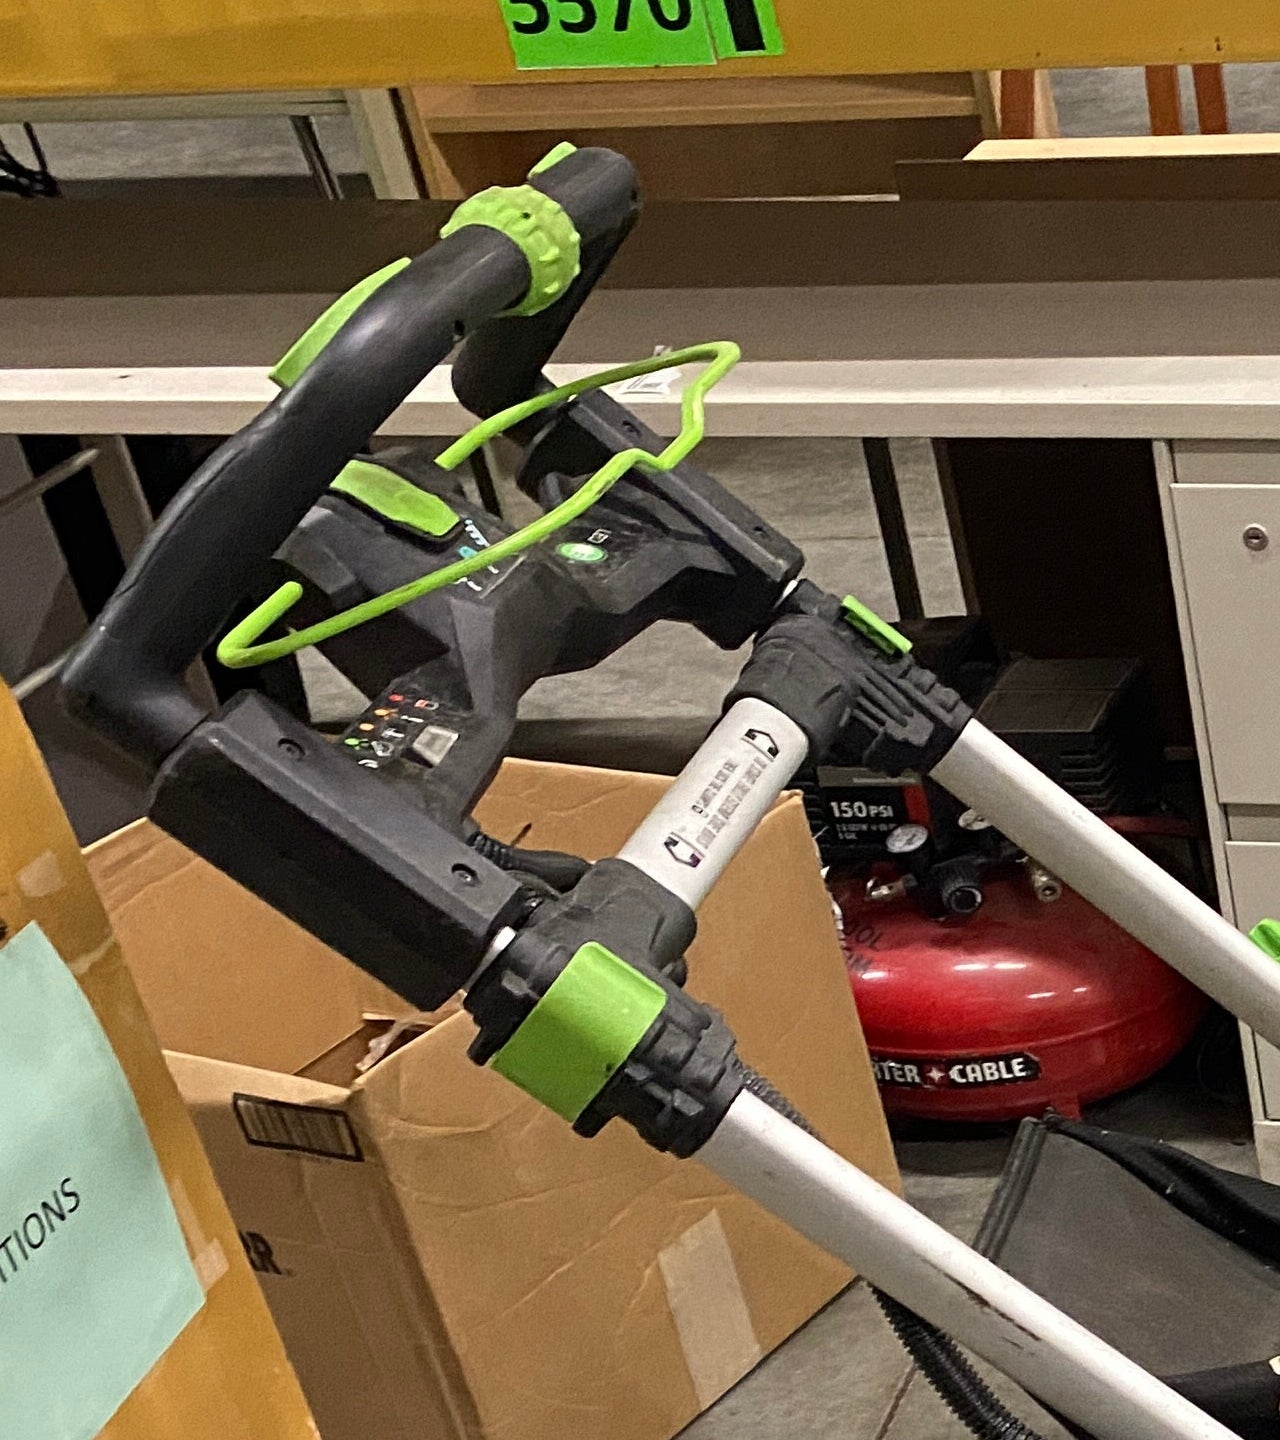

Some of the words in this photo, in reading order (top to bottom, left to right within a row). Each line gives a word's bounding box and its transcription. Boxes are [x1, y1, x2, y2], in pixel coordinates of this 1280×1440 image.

[830, 801, 867, 818] 150
[868, 805, 894, 817] PSI
[949, 1057, 1027, 1084] CABLE
[0, 1177, 80, 1283] TIONS
